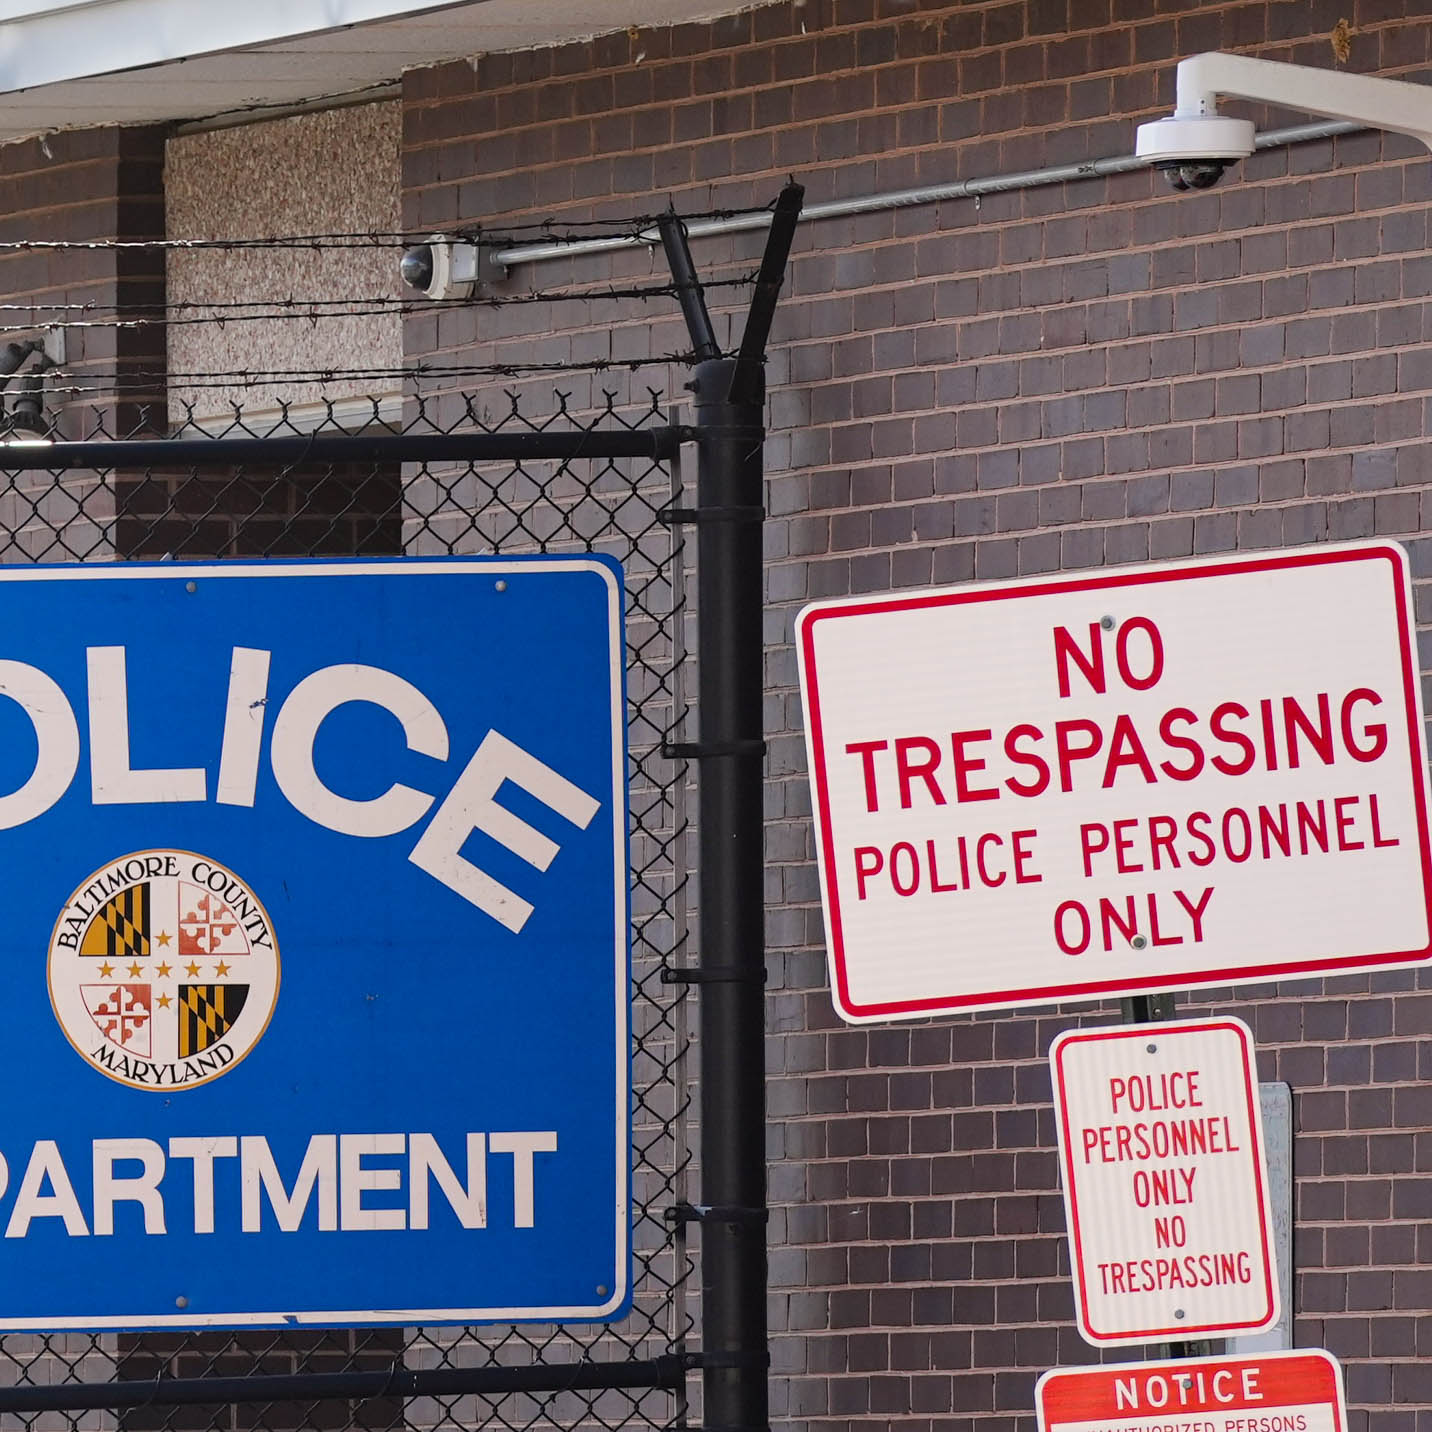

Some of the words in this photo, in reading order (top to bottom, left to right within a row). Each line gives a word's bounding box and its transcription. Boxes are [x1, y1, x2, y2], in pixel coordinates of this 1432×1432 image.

[1054, 616, 1165, 699] NO
[845, 687, 1389, 814] TRESPASSING
[855, 828, 1043, 901] POLICE
[1080, 793, 1401, 878] PERSONNEL
[57, 855, 181, 951] BALTIMORE
[191, 861, 273, 952] COUNTY
[1053, 886, 1216, 957] ONLY
[91, 1042, 235, 1085] MARYLAND
[1109, 1071, 1203, 1115] POLICE
[1081, 1116, 1240, 1165] PERSONNEL
[1132, 1167, 1197, 1209] ONLY
[1154, 1215, 1187, 1249] NO
[1096, 1250, 1253, 1296] TRESPASSING
[1115, 1367, 1264, 1411] NOTICE
